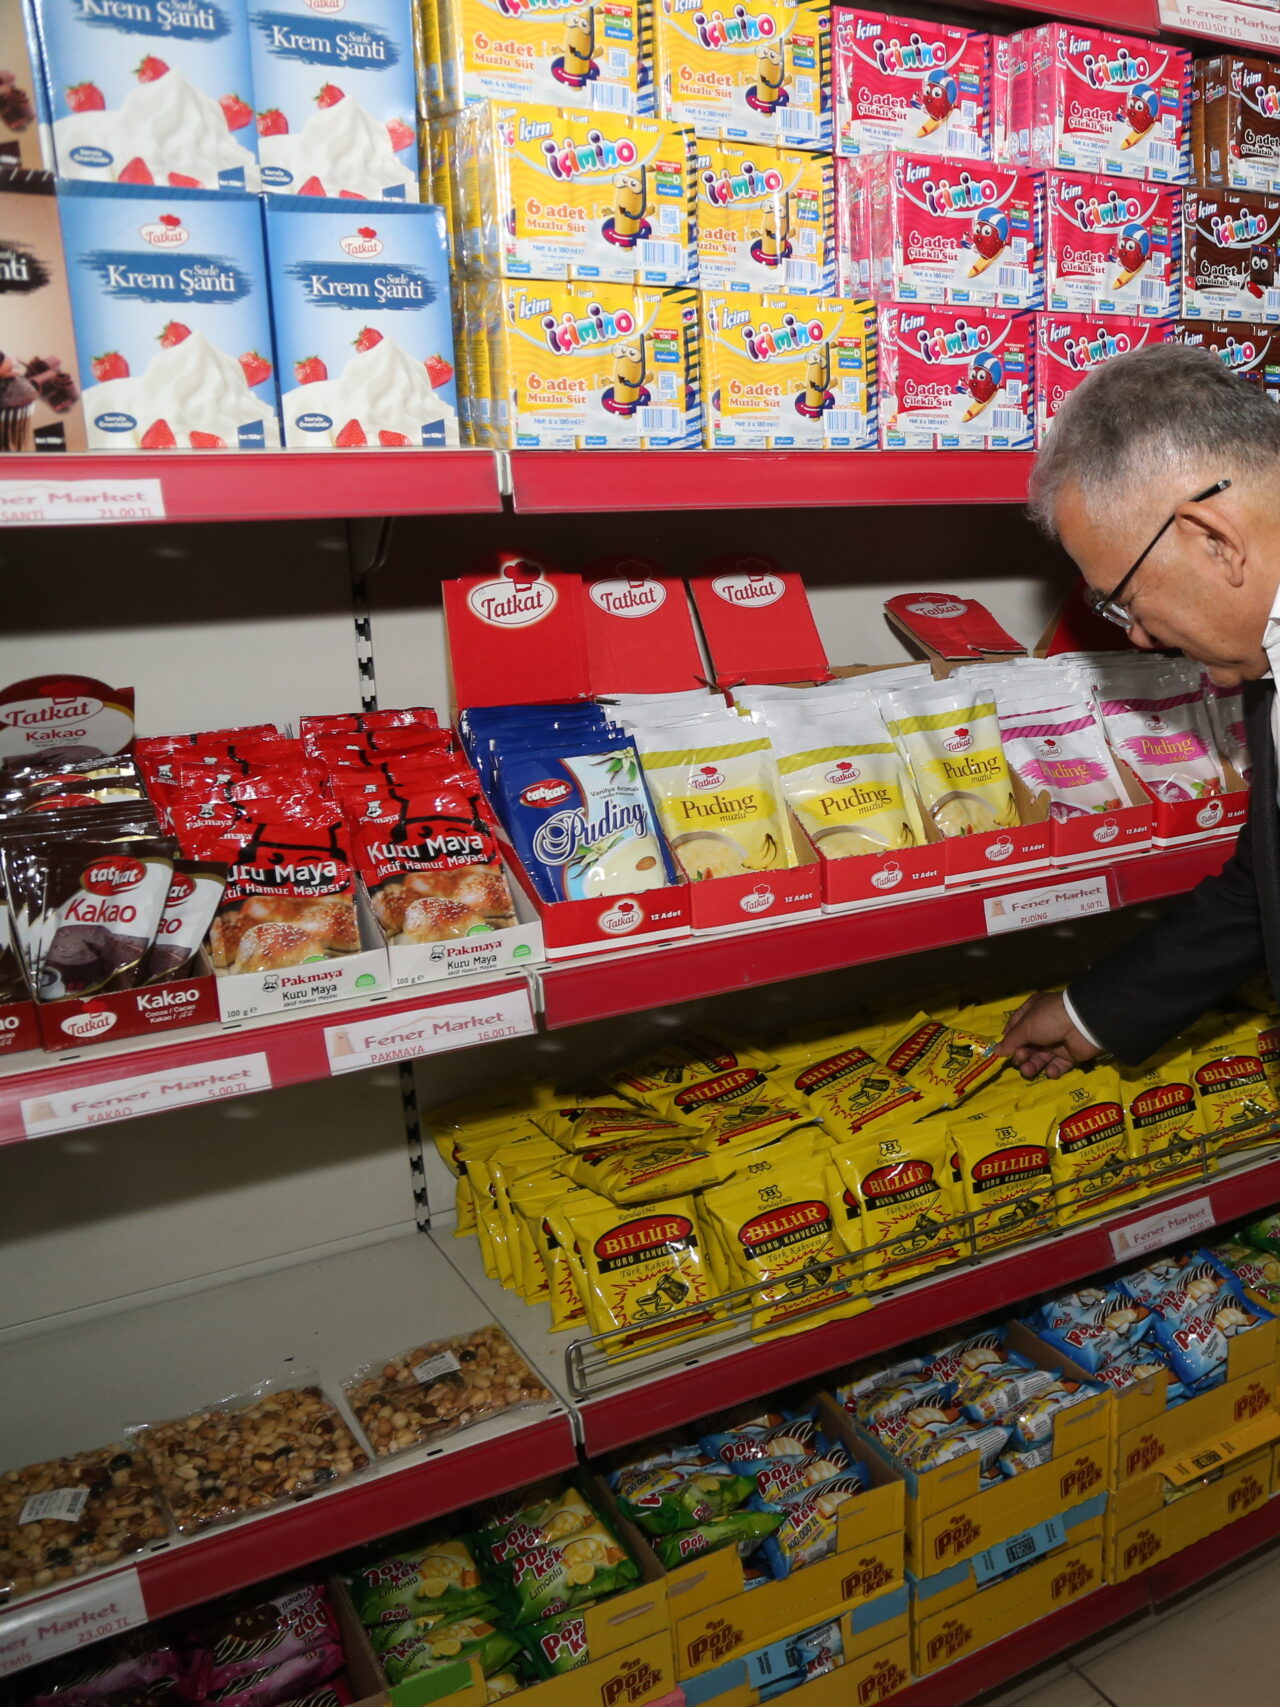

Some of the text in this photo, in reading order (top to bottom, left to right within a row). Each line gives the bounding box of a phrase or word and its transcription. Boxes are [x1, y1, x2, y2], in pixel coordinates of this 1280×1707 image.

[157, 3, 216, 31] Şanti
[1187, 4, 1231, 23] Fener
[856, 20, 881, 39] İçim
[1213, 22, 1228, 34] SÜT
[273, 25, 386, 61] Krem Şanti
[474, 35, 534, 57] 6 adet
[1069, 35, 1091, 53] İçim
[858, 87, 907, 108] 6 adet
[857, 104, 907, 121] Çilekli Süt
[519, 118, 552, 140] İçim
[526, 199, 585, 220] 6 adet
[526, 218, 586, 233] Muzlu Süt
[107, 265, 236, 296] Krem Şanti
[311, 274, 423, 304] Krem Şanti
[519, 297, 551, 319] İçim
[721, 307, 751, 329] İçim
[527, 375, 586, 392] 6 adet
[904, 379, 950, 397] 6 adet
[527, 392, 587, 405] Muzlu Süt
[903, 395, 953, 408] Çilekli Süt
[48, 492, 146, 504] Market
[600, 587, 657, 612] Tatkat
[722, 580, 777, 603] Tatkat
[480, 588, 543, 621] Tatkat
[4, 701, 90, 726] Tatkat
[25, 728, 87, 742] Kakao
[1141, 736, 1195, 756] Puding
[828, 770, 857, 784] Tatkat
[943, 756, 1001, 780] Puding
[524, 784, 569, 802] tatkat
[691, 776, 721, 789] Tatkat
[681, 795, 758, 820] Puding
[819, 787, 892, 817] Puding
[857, 802, 883, 815] muzlu
[719, 812, 747, 823] muzlu
[532, 802, 648, 866] Puding
[367, 833, 484, 865] Kuru Maya
[89, 864, 139, 885] tatkat
[274, 861, 338, 883] Maya
[377, 854, 488, 878] Aktif Hamur Mayası
[920, 870, 938, 879] Adet
[874, 873, 899, 888] Tatkat
[743, 895, 770, 912] Tatkat
[793, 892, 812, 902] Adet
[1011, 886, 1102, 913] Fener Market
[64, 898, 137, 924] Kakao
[650, 909, 681, 921] 12 Adet
[1020, 911, 1048, 925] PUDİNG
[1095, 901, 1104, 909] TL
[605, 914, 636, 931] Tatkat
[447, 941, 502, 957] Pakmaya
[448, 955, 497, 970] Kuru Maya
[280, 969, 341, 988] Pakmaya
[136, 989, 199, 1011] Kakao
[282, 983, 338, 1001] Kuru Maya
[227, 1009, 242, 1018] 100
[67, 1014, 114, 1038] Tatkat
[364, 1012, 505, 1049] Fener Market
[371, 1045, 425, 1064] PAKMAYA
[507, 1026, 518, 1034] TL
[1202, 1061, 1257, 1083] BİLLÜR
[72, 1069, 252, 1114] Fener Market
[681, 1070, 749, 1102] BİLLÜR
[87, 1107, 132, 1124] KAKAO
[236, 1083, 248, 1093] TL
[1064, 1107, 1119, 1140] BİLLÜR
[980, 1153, 1043, 1179] BİLLÜR
[748, 1206, 821, 1241] BİLLÜR
[1134, 1226, 1164, 1243] Fener
[1168, 1208, 1206, 1229] Market
[604, 1222, 680, 1254] BİLLÜR
[755, 1222, 828, 1255] KURU KAHVECİSİ
[377, 1575, 419, 1599] Limonlu
[528, 1565, 564, 1601] Limonlu
[37, 1602, 118, 1641] Market
[115, 1616, 130, 1628] TL
